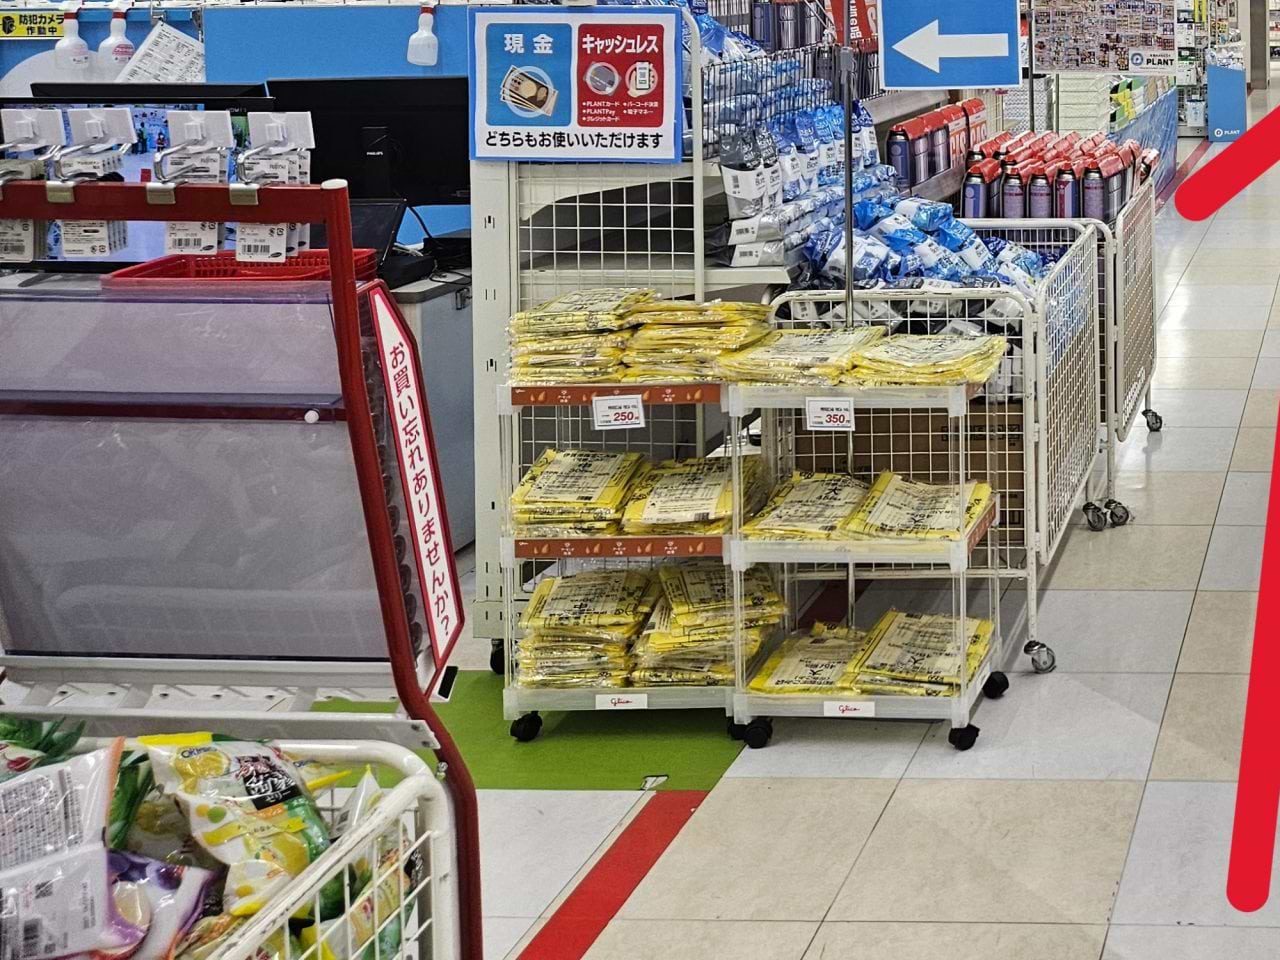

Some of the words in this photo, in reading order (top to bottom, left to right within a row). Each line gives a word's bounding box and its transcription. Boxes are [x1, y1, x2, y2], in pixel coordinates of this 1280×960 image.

[19, 14, 64, 24] 防犯カメラ
[26, 26, 57, 35] 作動中
[504, 33, 553, 54] 現金
[582, 34, 659, 55] キャッシュレス
[486, 131, 663, 148] どちらもお使いいただけます
[389, 341, 452, 637] お買い忘れありませんか?
[611, 697, 632, 706] Glico
[839, 705, 860, 713] Glico
